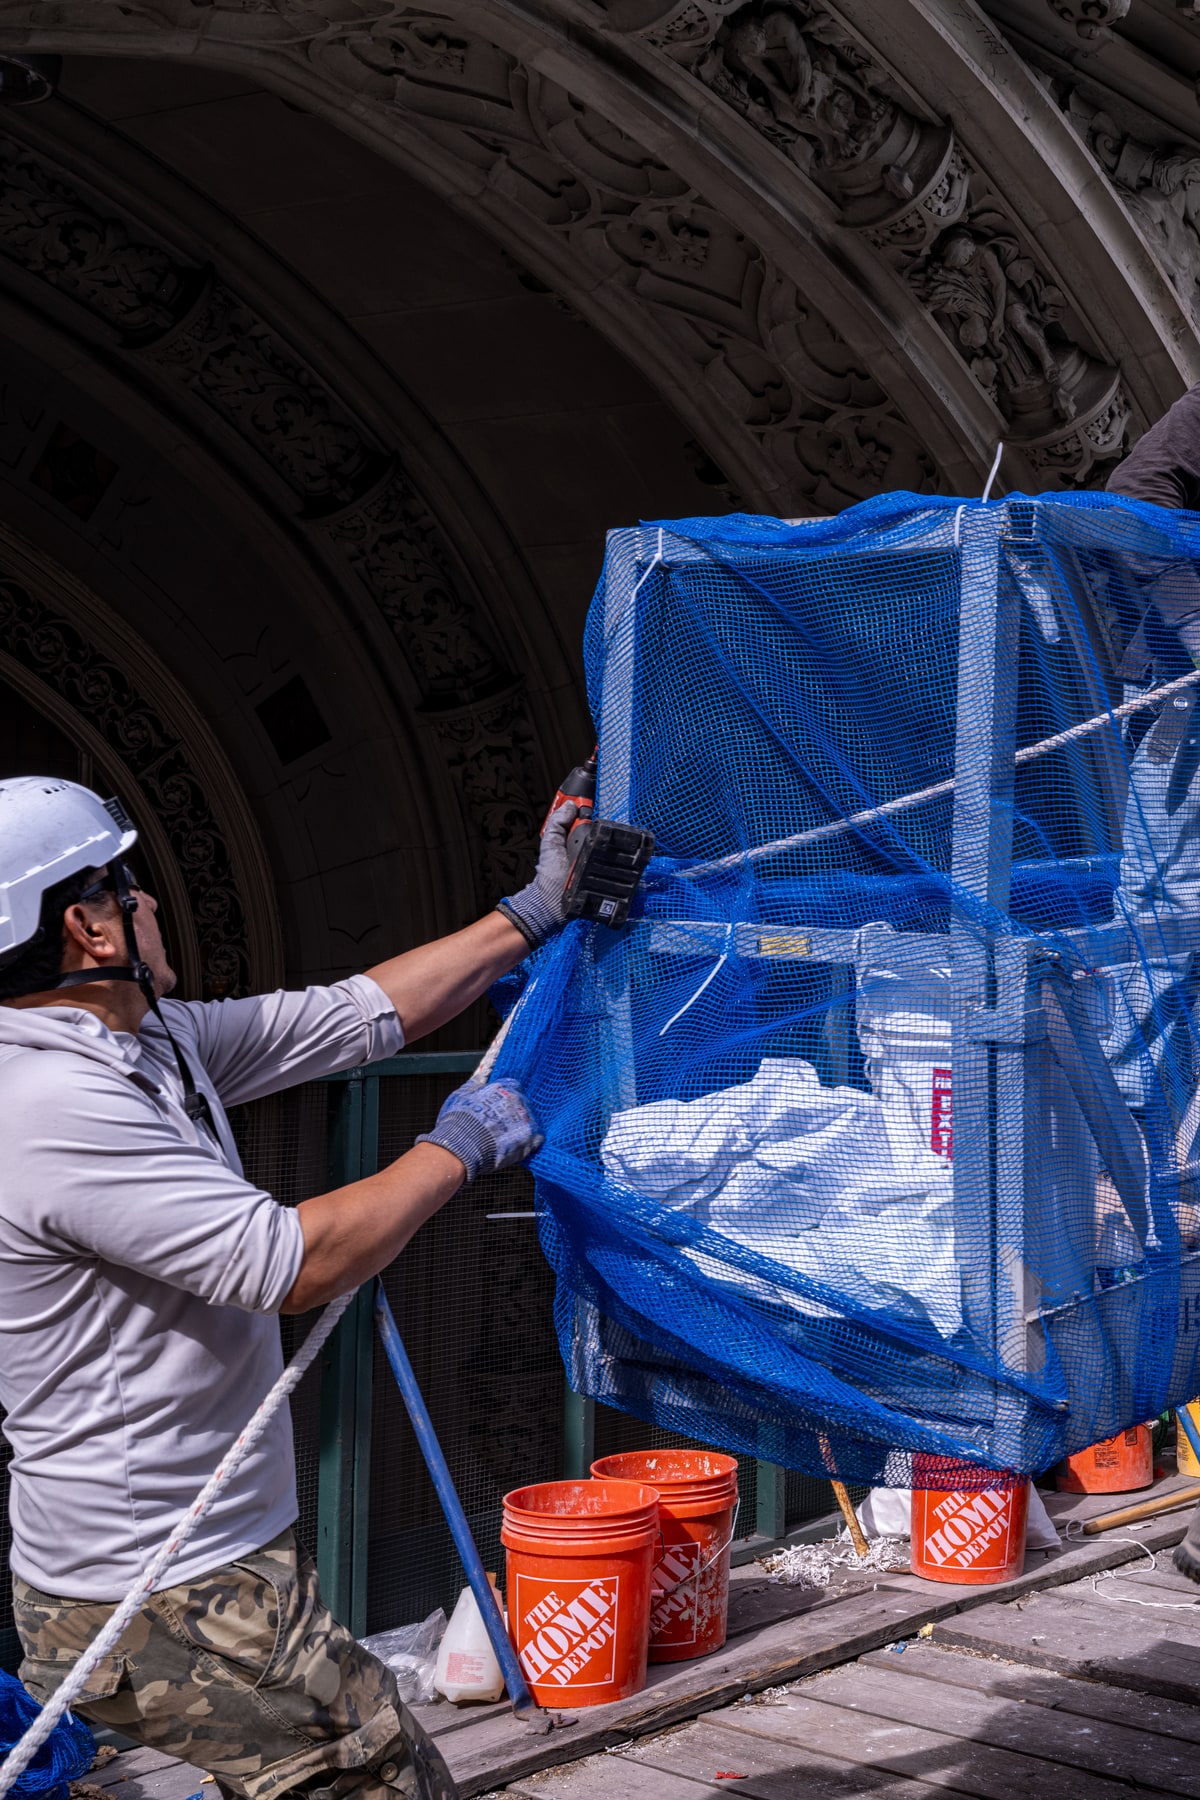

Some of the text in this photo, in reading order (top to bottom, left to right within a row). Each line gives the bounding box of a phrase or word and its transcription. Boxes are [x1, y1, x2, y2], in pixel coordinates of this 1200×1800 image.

[924, 1484, 1012, 1566] HOME
[932, 1490, 970, 1522] THE
[953, 1512, 1010, 1569] DEPOT
[519, 1580, 617, 1683] HOME
[524, 1591, 566, 1633] THE
[550, 1616, 615, 1686] DEPOT
